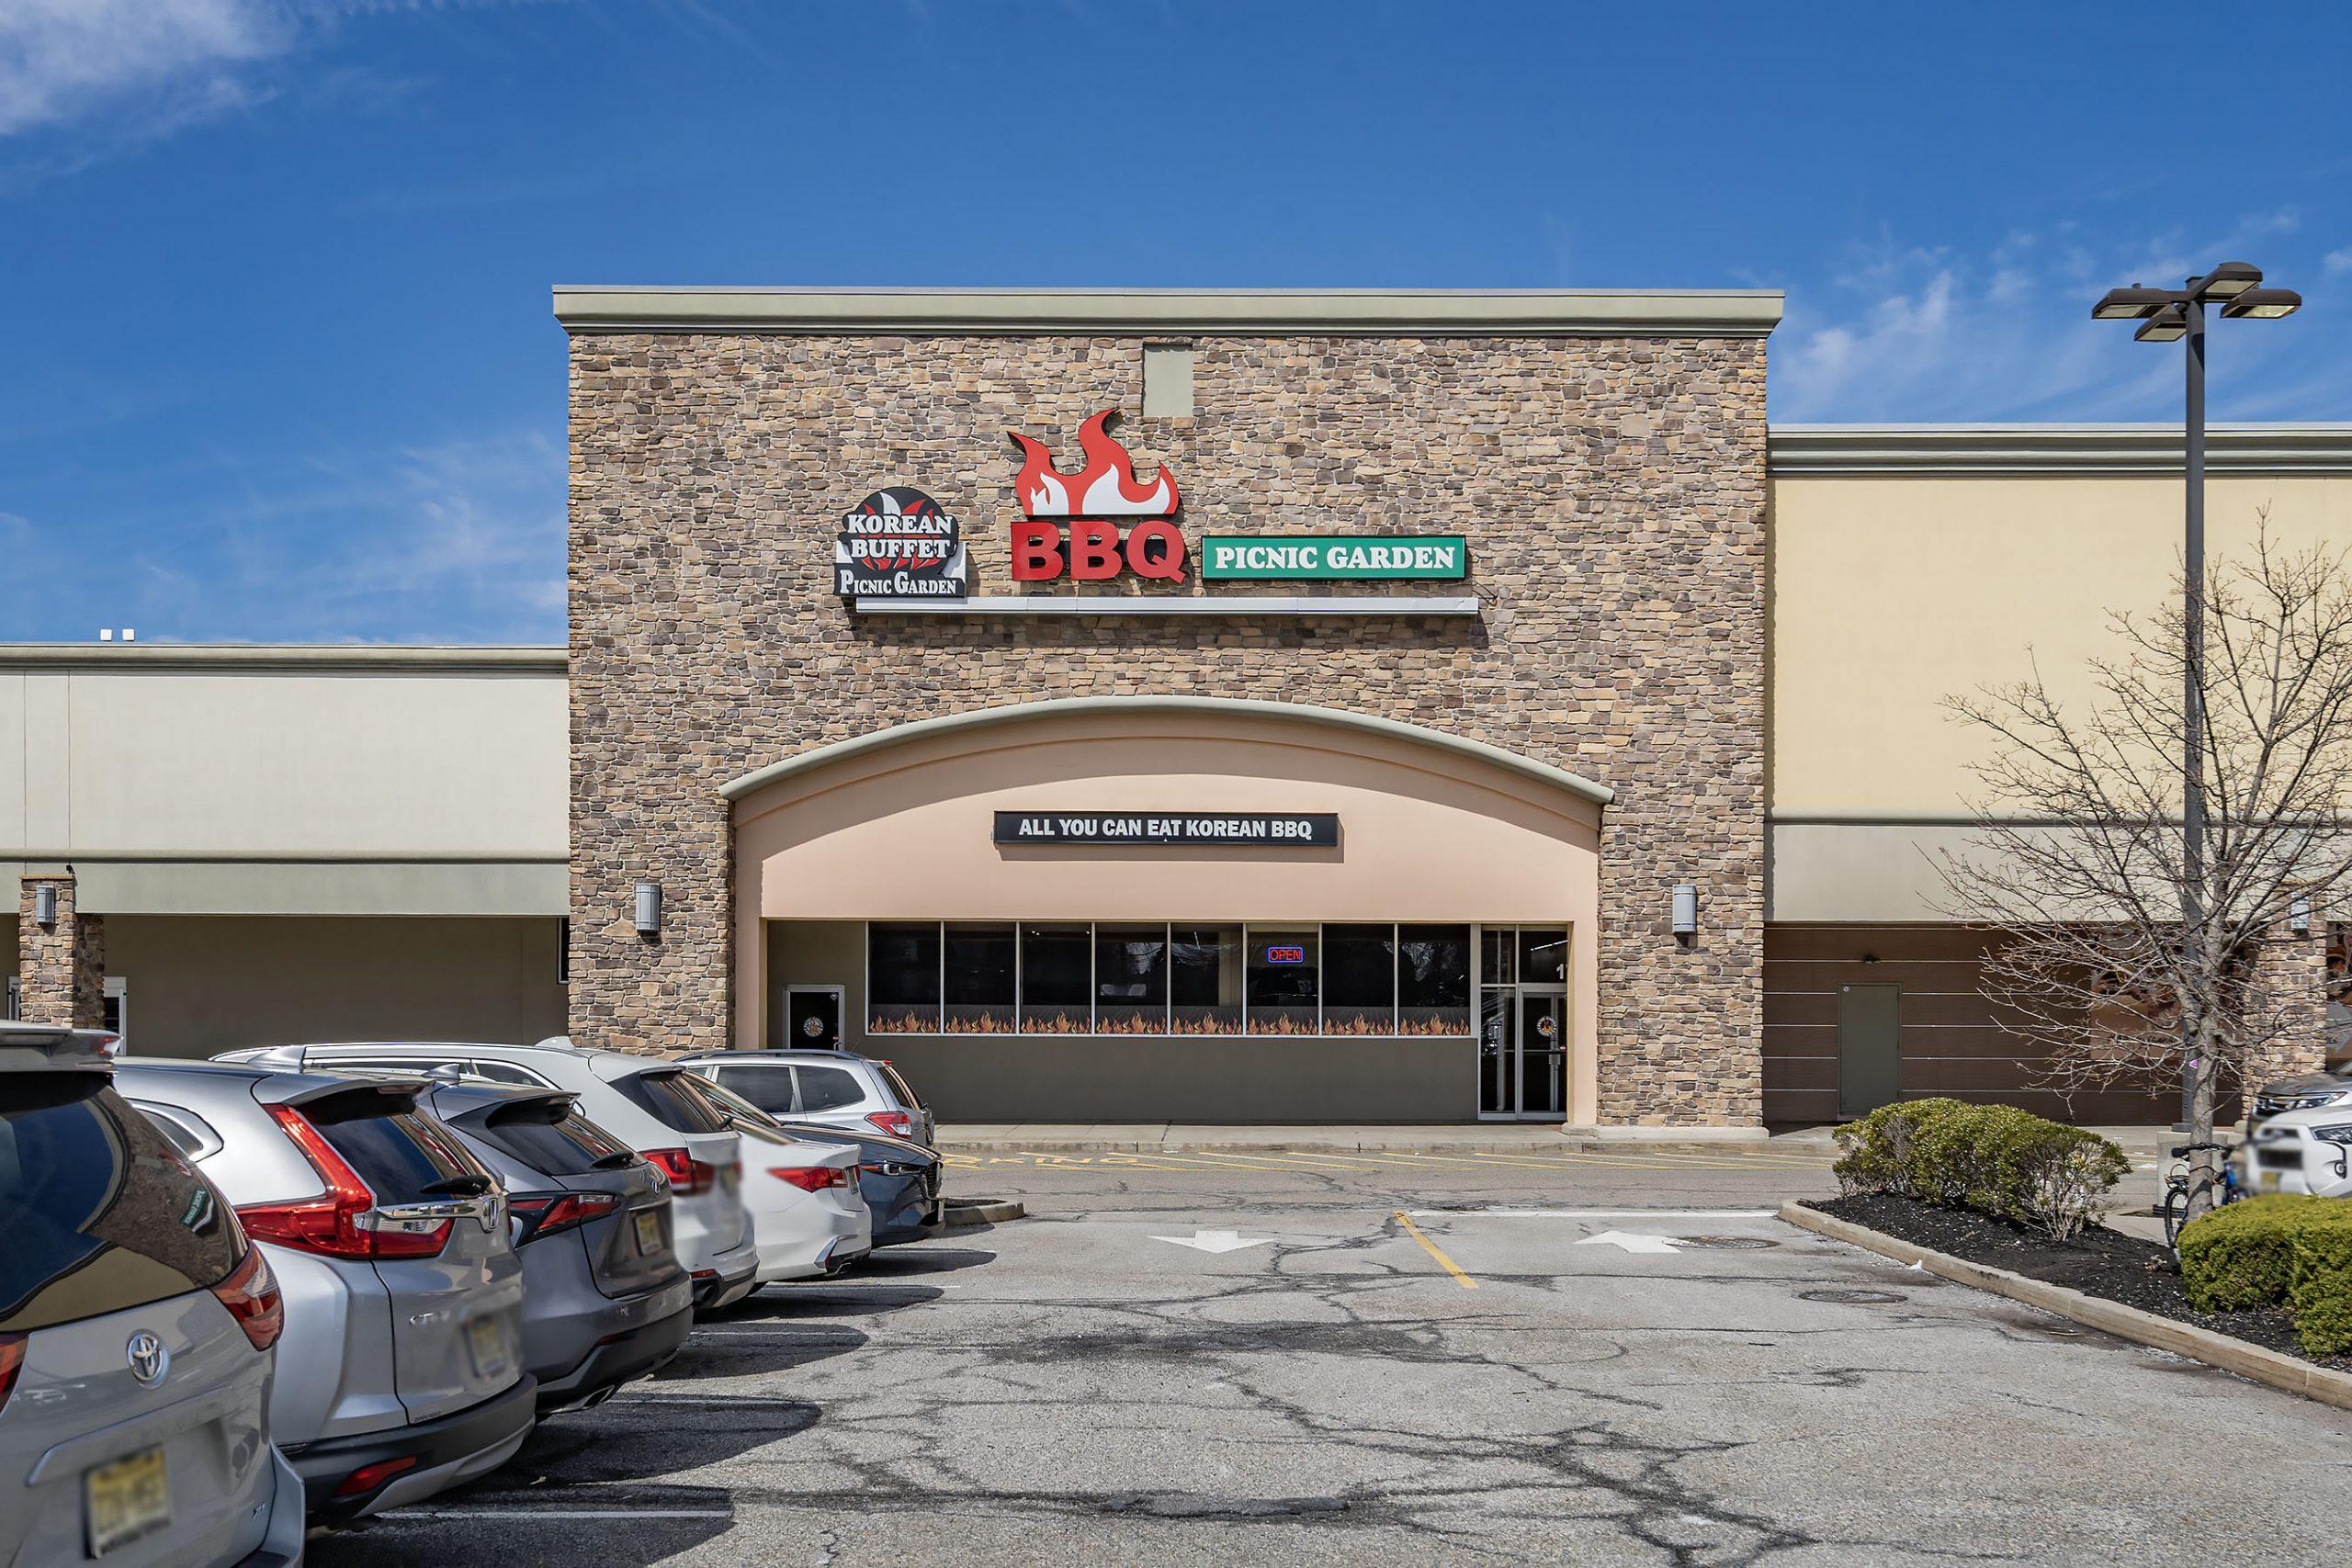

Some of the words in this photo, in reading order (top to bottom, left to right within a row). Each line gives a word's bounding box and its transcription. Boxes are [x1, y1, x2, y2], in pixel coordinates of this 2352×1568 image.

[847, 514, 953, 535] KOREAN
[851, 539, 951, 558] BUFFET
[1011, 520, 1187, 584] BBQ
[1215, 547, 1317, 570] PICNIC
[1327, 547, 1455, 570] GARDEN
[840, 570, 892, 594] PICNIC
[894, 571, 957, 594] GARDEN
[1018, 818, 1056, 836] ALL
[1058, 818, 1098, 836] YOU
[1102, 818, 1142, 836] CAN
[1147, 818, 1182, 837] EAT
[1186, 819, 1266, 838] KOREAN
[1271, 820, 1312, 840] BBQ
[1270, 949, 1301, 961] OPEN
